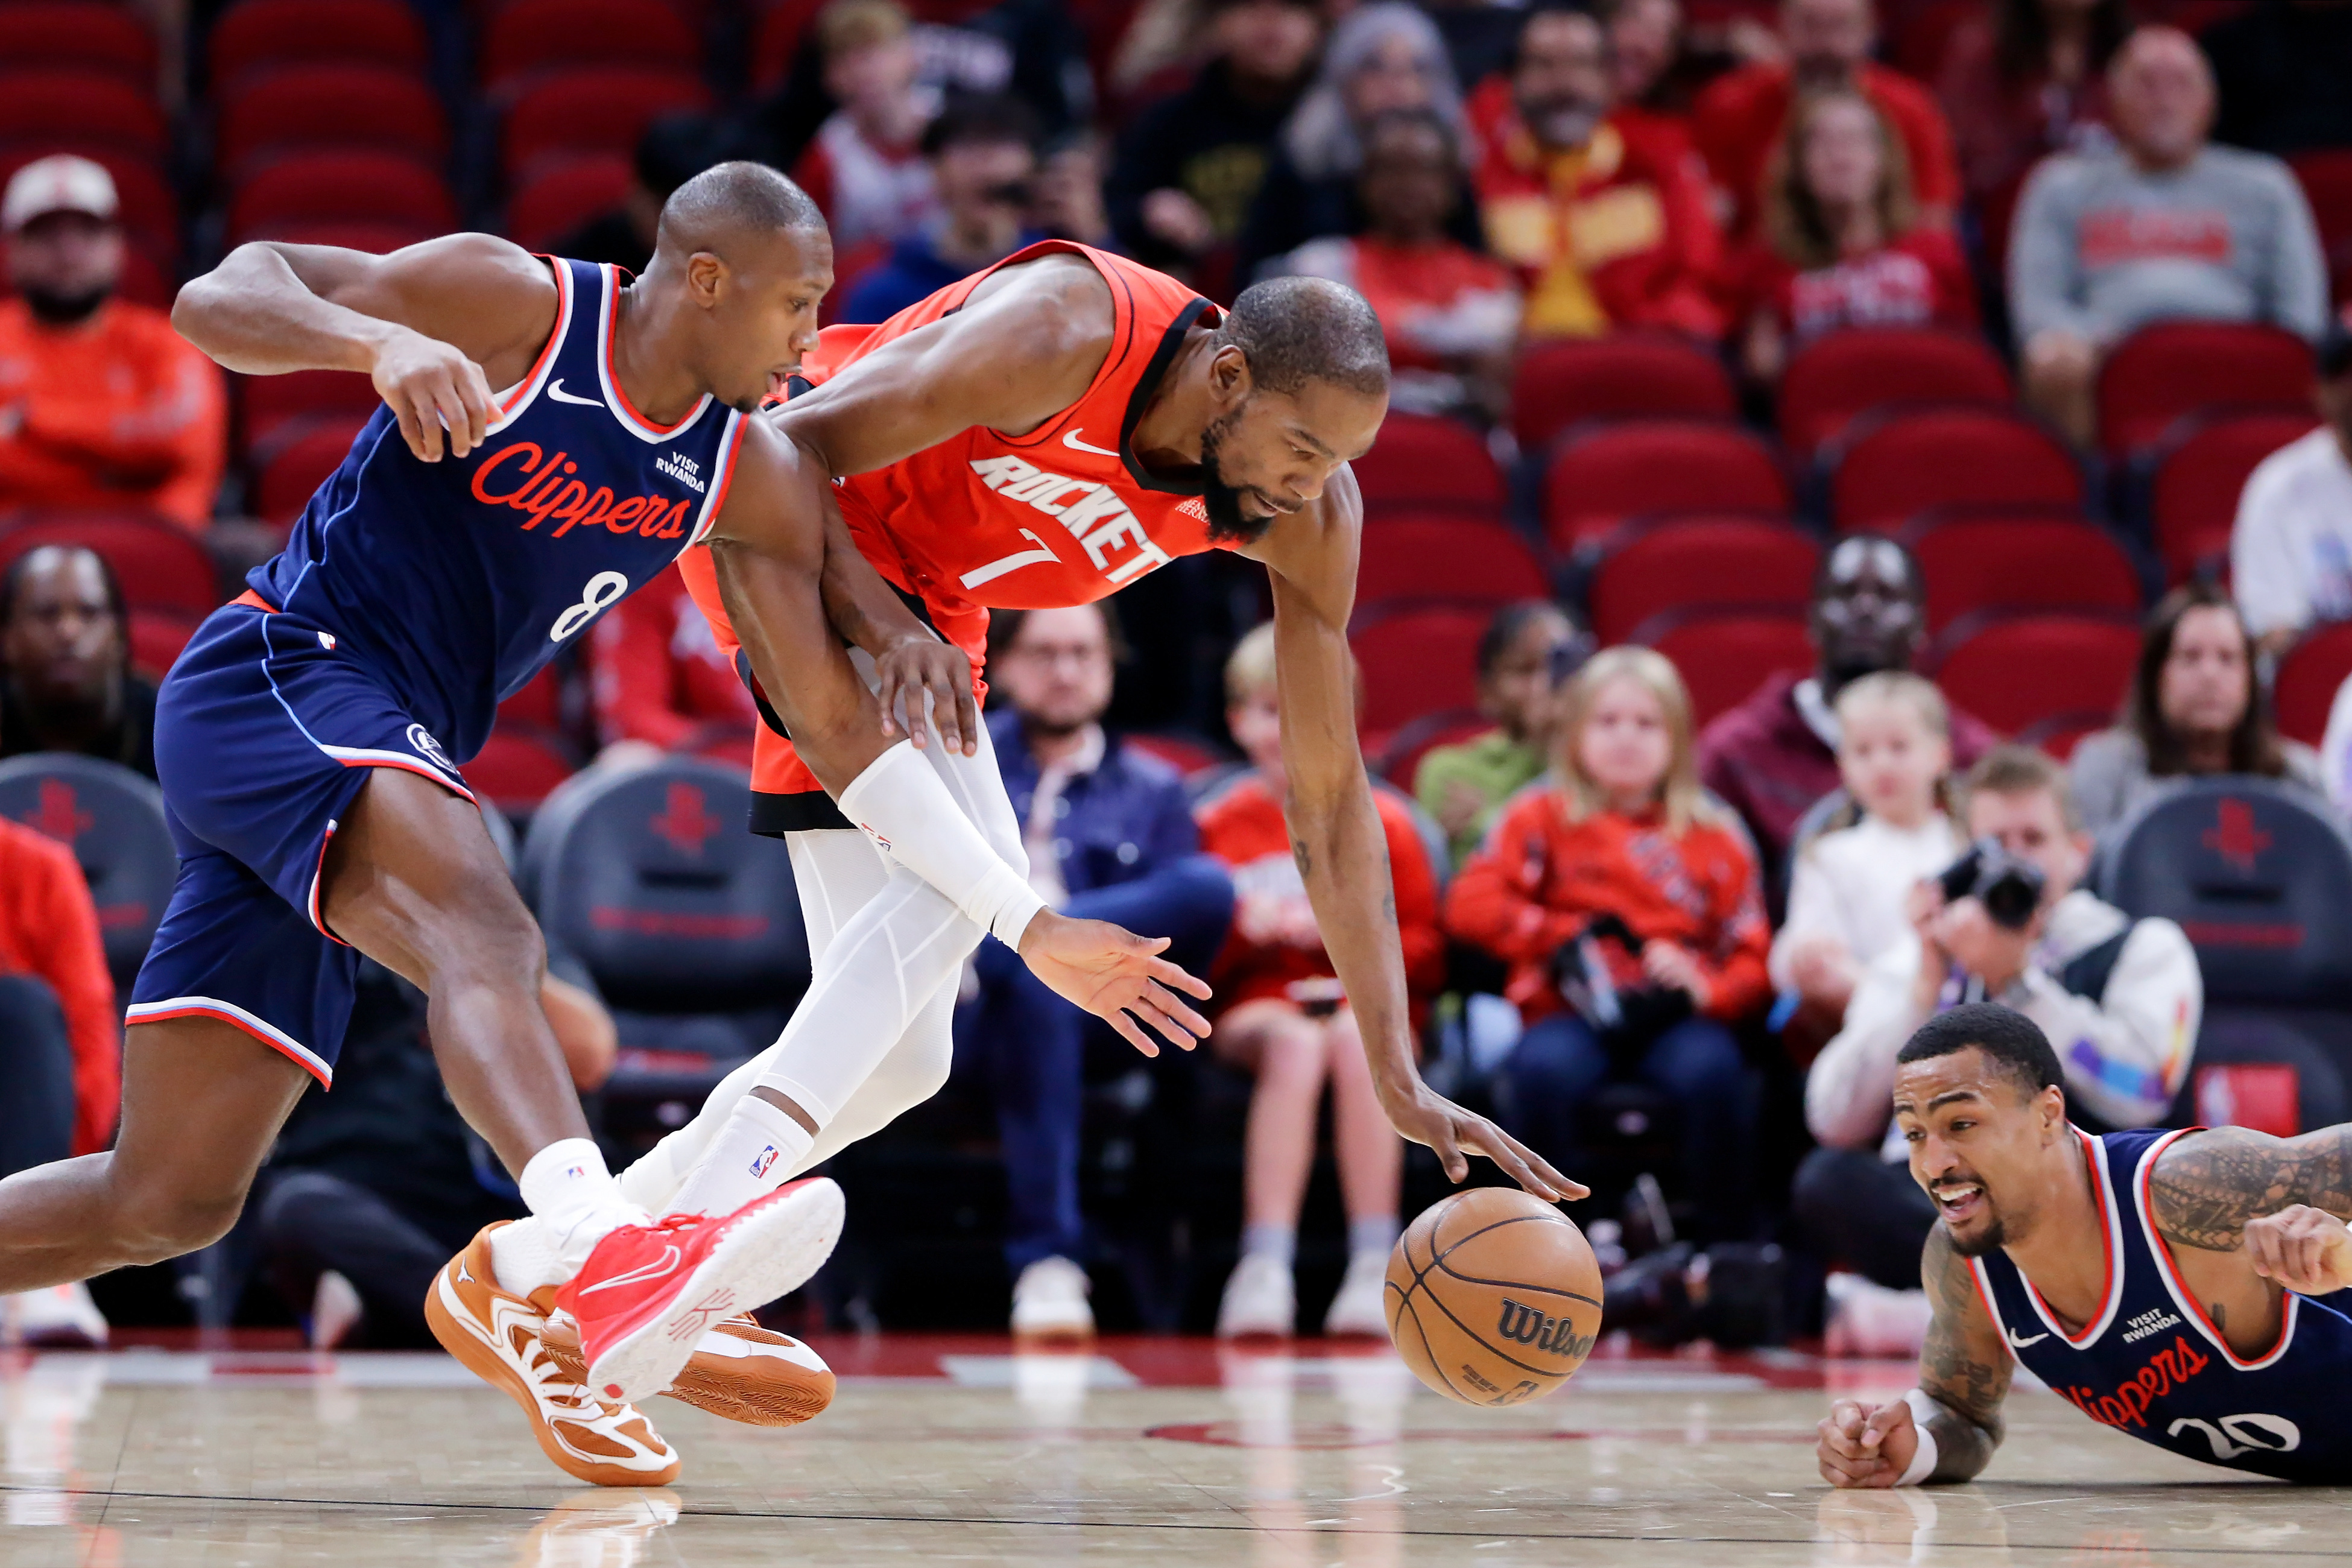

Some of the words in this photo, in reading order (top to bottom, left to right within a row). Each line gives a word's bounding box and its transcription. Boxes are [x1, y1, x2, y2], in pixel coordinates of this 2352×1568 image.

[471, 441, 691, 539] Clippers
[656, 457, 704, 493] RWANDA
[672, 451, 699, 475] VISIT
[969, 454, 1177, 587] ROCKET
[959, 528, 1062, 590] 7
[549, 571, 628, 643] 8
[1498, 1297, 1598, 1359] Wilso
[2122, 1314, 2181, 1344] RWANDA
[2126, 1308, 2162, 1329] VISIT
[2167, 1412, 2301, 1460] 20
